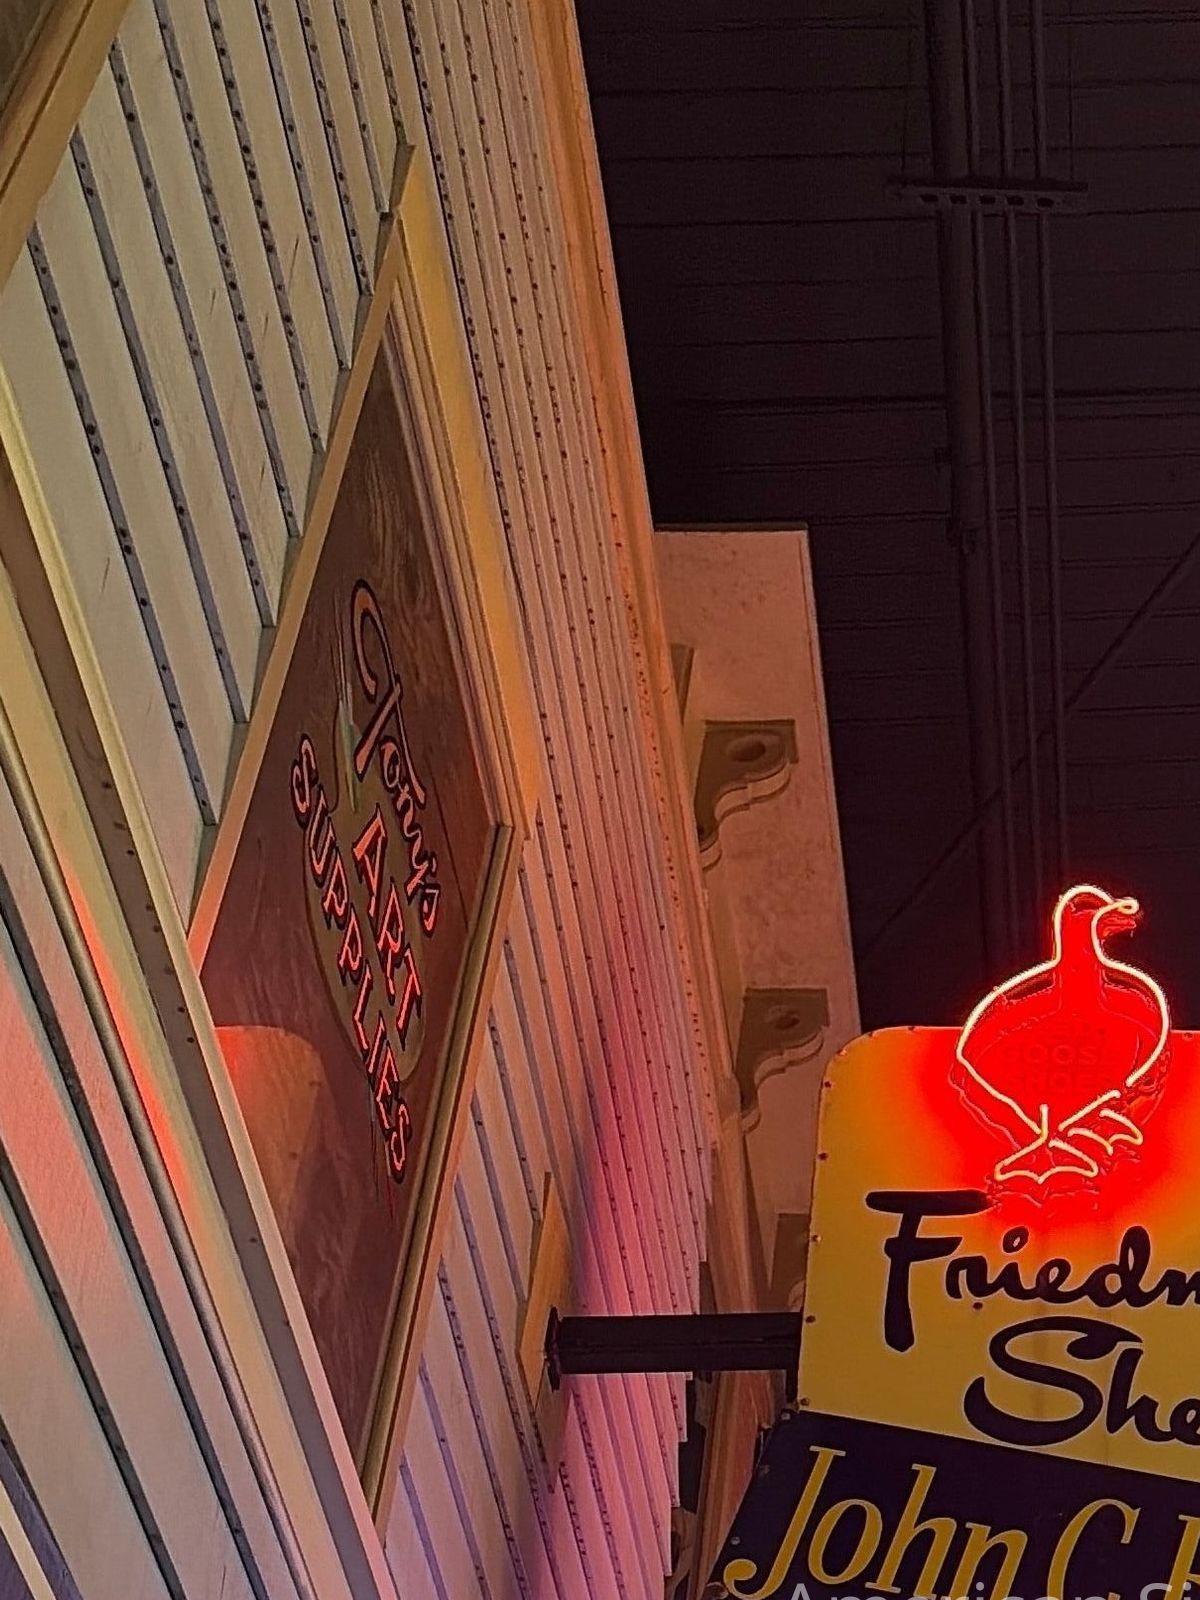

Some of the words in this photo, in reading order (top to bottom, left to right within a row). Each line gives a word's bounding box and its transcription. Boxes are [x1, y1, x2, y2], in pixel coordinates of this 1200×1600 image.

[352, 578, 440, 936] Tony's
[352, 803, 422, 1050] ART
[291, 734, 412, 1182] SUPPLIES
